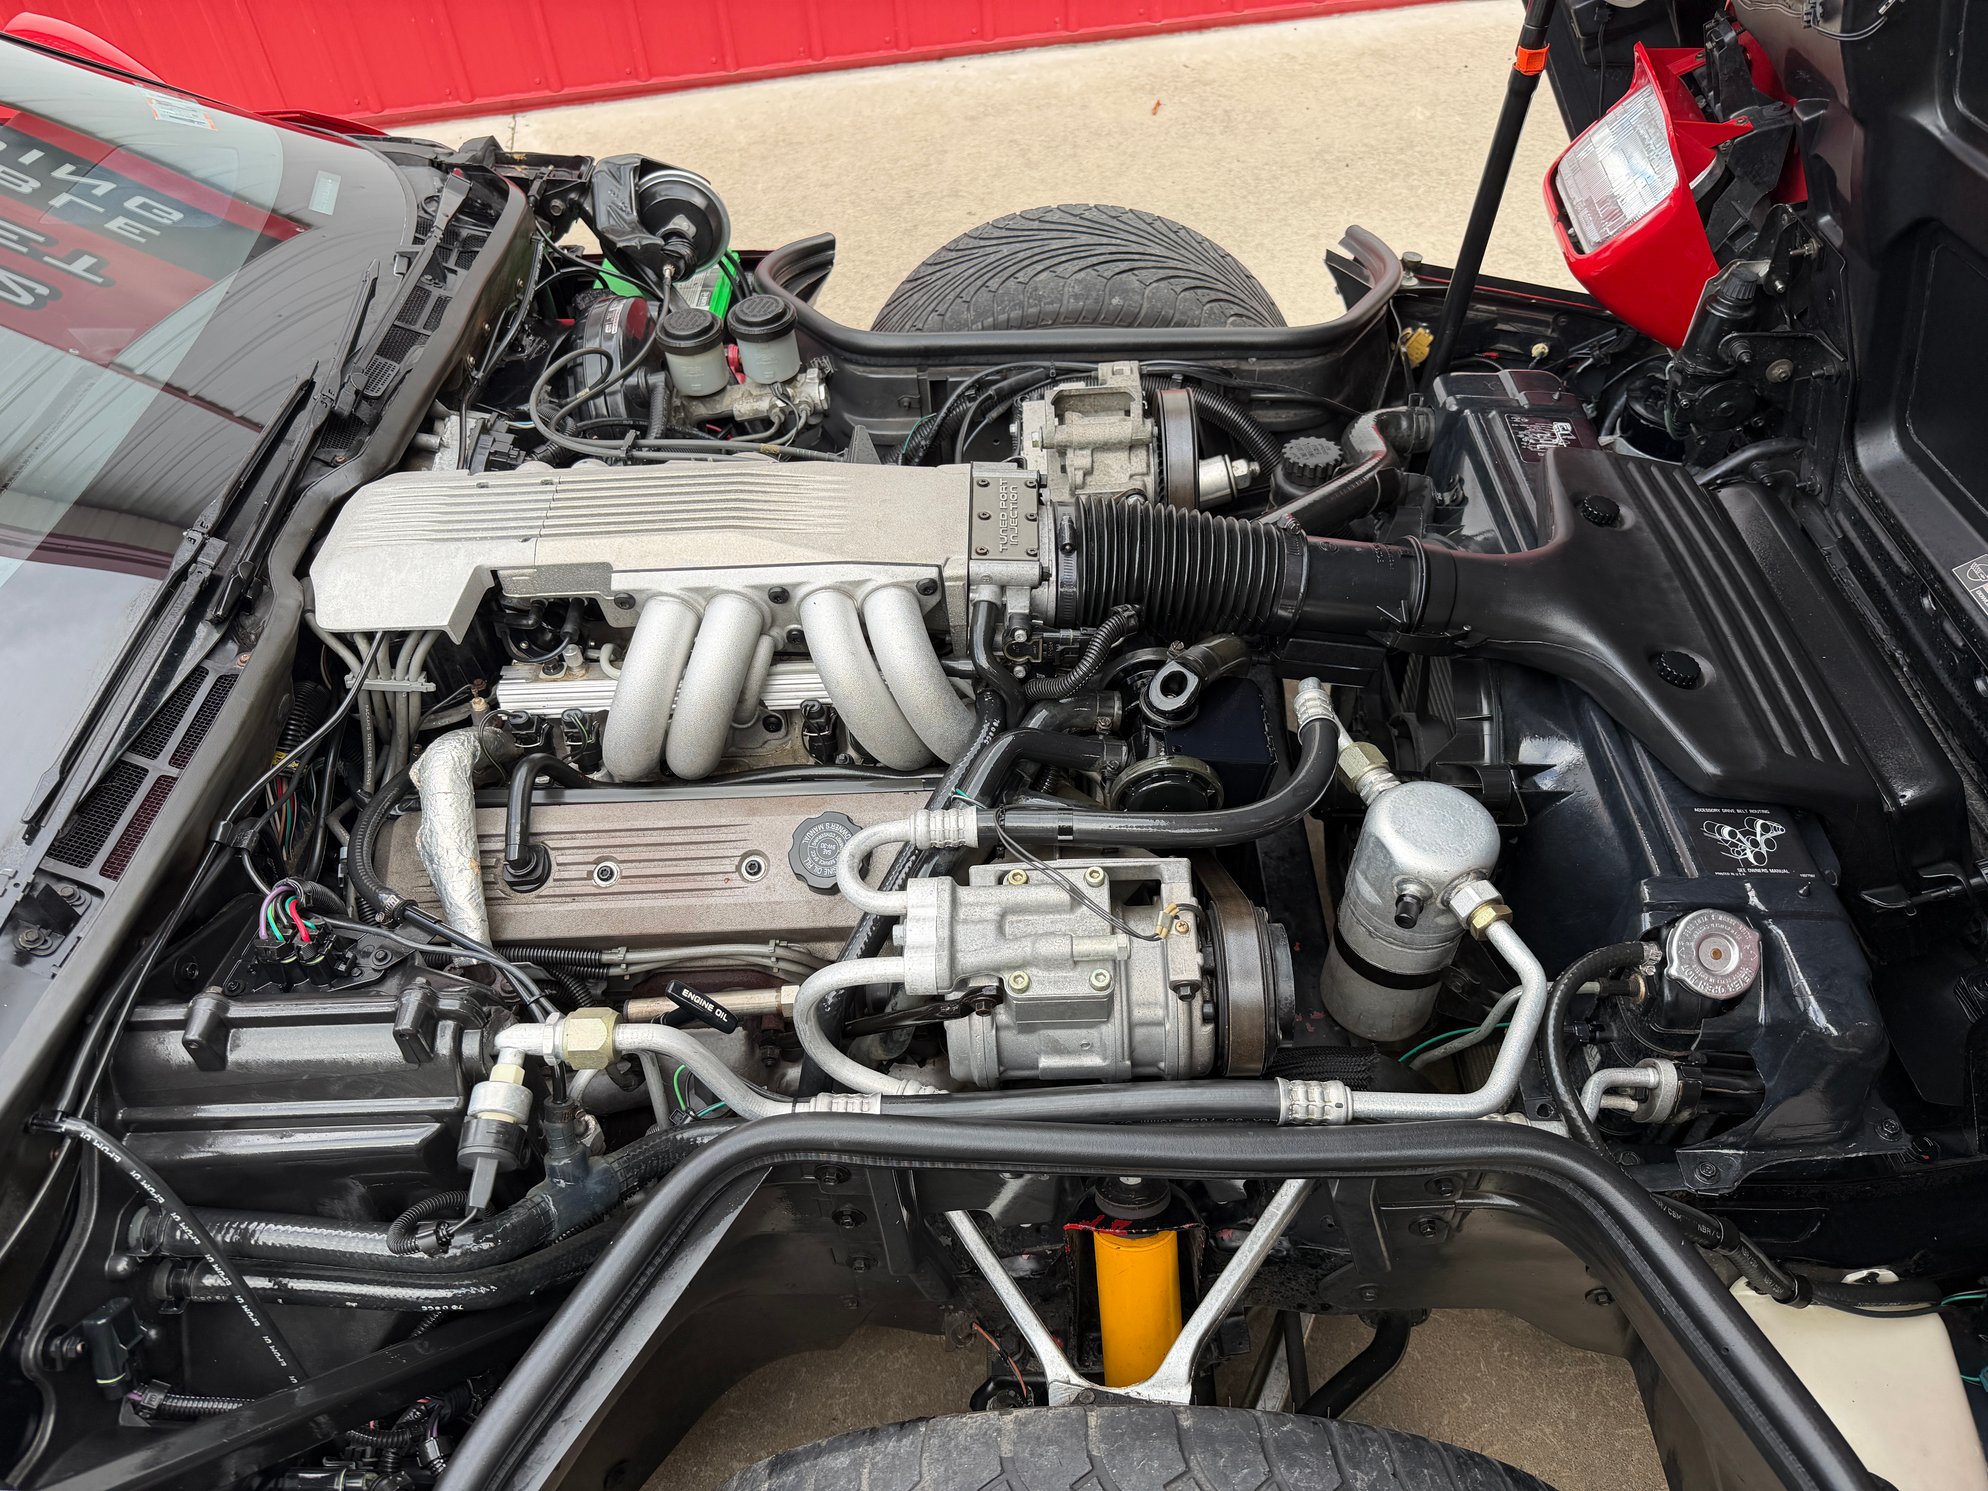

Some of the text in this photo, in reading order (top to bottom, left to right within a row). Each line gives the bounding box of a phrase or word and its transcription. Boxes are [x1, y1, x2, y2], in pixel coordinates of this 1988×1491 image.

[999, 478, 1009, 552] TUNED PORT
[1009, 485, 1019, 546] INJECTION
[802, 824, 825, 844] MANUAL
[1680, 965, 1698, 984] HOT
[1728, 967, 1754, 992] NEVER
[1698, 982, 1726, 994] OPEN
[681, 988, 728, 1022] ENGINE OIL
